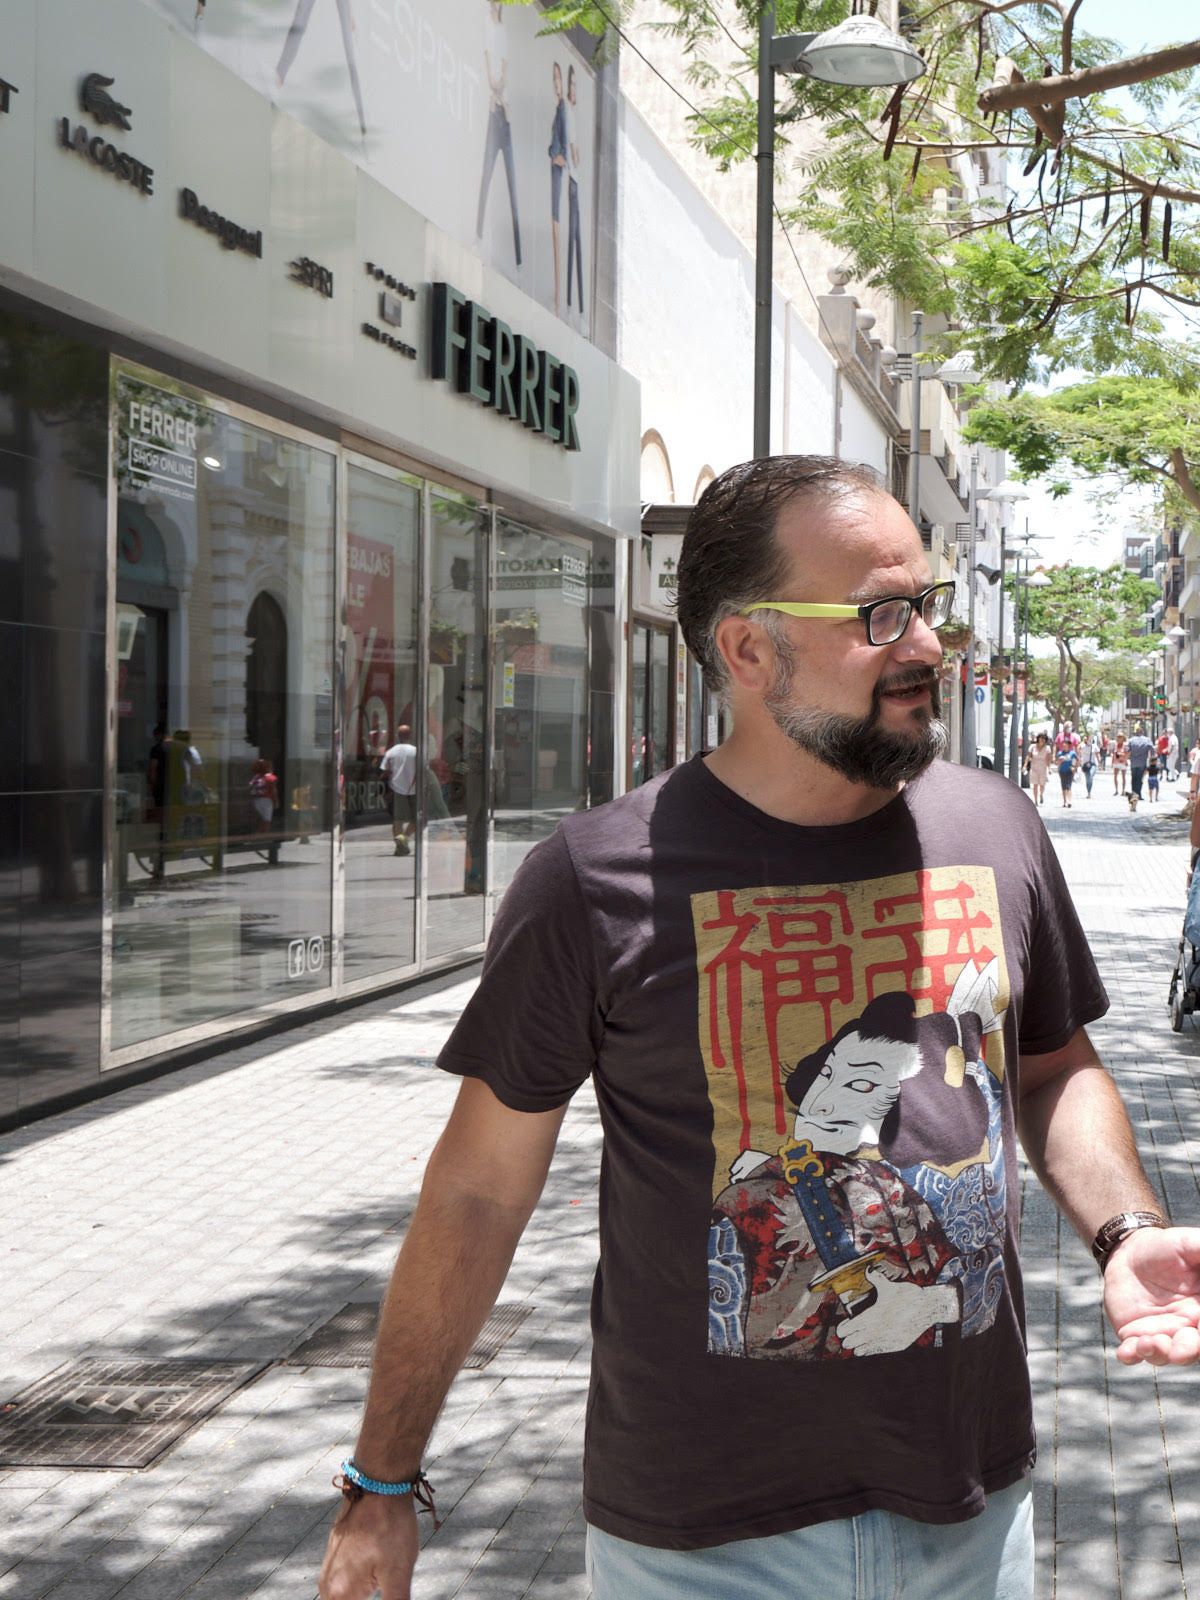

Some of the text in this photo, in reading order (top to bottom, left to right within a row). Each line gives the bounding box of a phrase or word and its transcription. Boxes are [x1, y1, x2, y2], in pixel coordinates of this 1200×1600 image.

[59, 117, 153, 196] LACOSTE
[179, 187, 262, 259] Desigual
[432, 281, 581, 452] FERRER
[130, 401, 197, 451] FERRER
[133, 447, 194, 480] SHOP ONLINE
